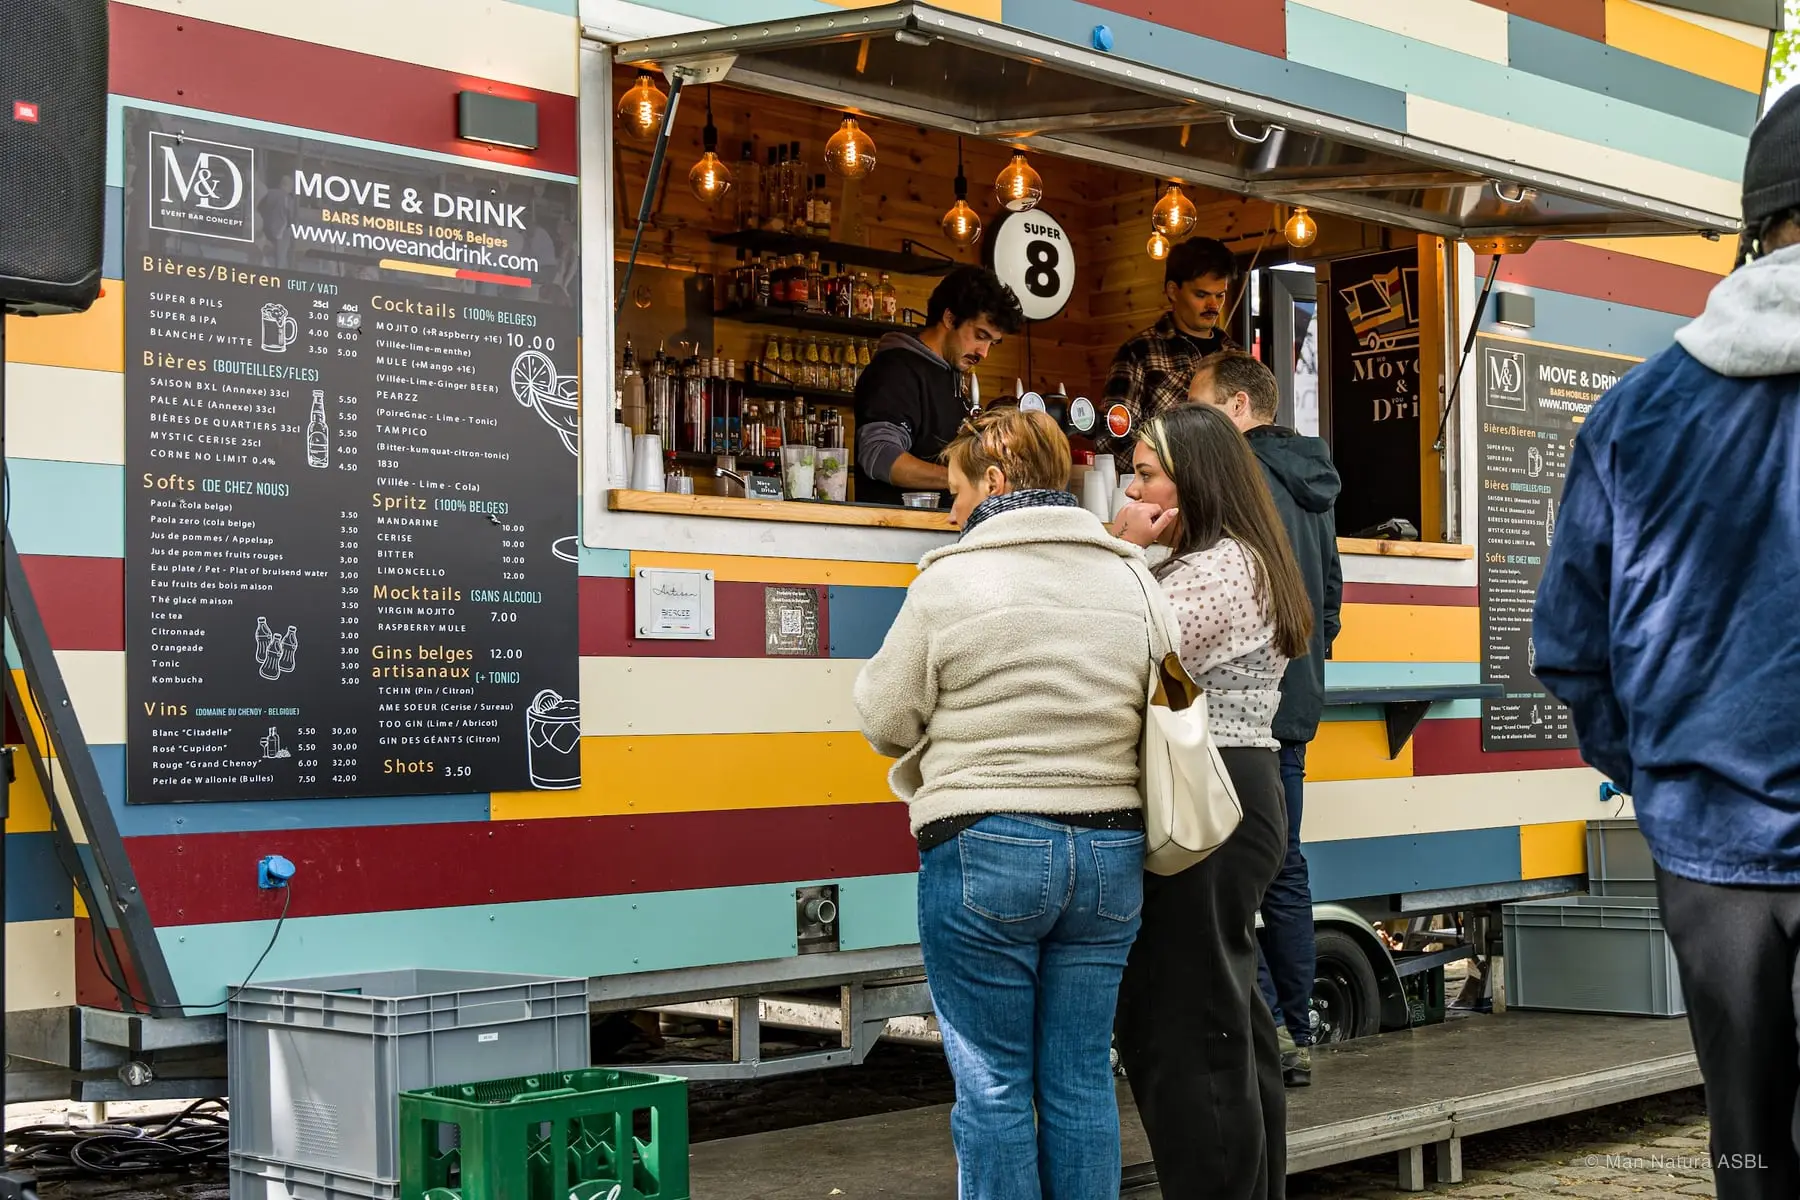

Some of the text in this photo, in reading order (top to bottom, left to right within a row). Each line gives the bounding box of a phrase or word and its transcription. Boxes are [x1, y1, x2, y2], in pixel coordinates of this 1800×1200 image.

[295, 170, 526, 230] MOVE & DRINK
[161, 209, 186, 218] EVENT
[206, 215, 243, 226] CONCEPT
[322, 209, 508, 248] BARS MOBILES 100% Belges
[1023, 222, 1061, 240] SUPER
[291, 223, 539, 273] www.moveanddrink.com
[143, 256, 281, 288] Bières/Bieren
[1025, 240, 1060, 297] 8
[287, 279, 307, 292] (FUT
[318, 282, 338, 295] VAT)
[150, 292, 223, 308] SUPER 8 PILS
[313, 300, 358, 312] 25cl 40cl
[371, 295, 456, 319] Cocktails
[150, 310, 217, 324] SUPER 8 IPA
[308, 312, 329, 321] 3.00
[463, 307, 536, 327] (100% BELGES)
[150, 328, 205, 341] BLANCHE
[217, 335, 253, 347] WITTE
[308, 329, 358, 341] 4.00 6.00
[376, 322, 502, 345] MOJITO (+Raspberry +1€)
[376, 340, 472, 357] (Villée-lime-menthe)
[507, 333, 555, 351] 10.00
[309, 346, 358, 358] 3.50 5.00
[143, 351, 319, 382] Bières (BOUTEILLES/FLES)
[376, 357, 475, 375] MULE (+Mango +1€)
[1540, 365, 1577, 385] MOVE
[1580, 371, 1589, 387] &
[150, 377, 290, 398] SAISON BXL (Annexe) 33cl
[376, 374, 499, 393] (Villée-Lime-Ginger BEER)
[1396, 379, 1408, 393] &
[338, 396, 358, 404] 5.50
[376, 391, 418, 402] PEARZZ
[1550, 388, 1590, 400] BARS MOBILES
[150, 396, 275, 414] PALE ALE (Annexe) 33cl
[150, 413, 300, 433] BIÈRES DE QUARTIERS 33cl
[338, 413, 358, 421] 5.50
[338, 430, 358, 438] 5.50
[376, 425, 428, 437] TAMPICO
[1483, 423, 1536, 438] Bières/Bieren
[151, 431, 261, 447] MYSTIC CERISE 25cl
[337, 446, 358, 454] 4.00
[376, 442, 509, 460] (Bitter-kumquat-citron-tonic)
[151, 449, 276, 466] CORNE NO LIMIT 0.4%
[377, 460, 399, 468] 1830
[338, 463, 358, 472] 4.50
[143, 473, 289, 497] Softs (DE CHEZ NOUS)
[1484, 480, 1509, 492] Bières
[372, 493, 427, 511] Spritz
[434, 499, 509, 515] (100% BELGES)
[377, 517, 439, 528] MANDARINE
[502, 525, 525, 533] 10.00
[377, 534, 413, 542] CERISE
[502, 540, 525, 548] 10.00
[377, 551, 414, 559] BITTER
[1485, 552, 1506, 563] Softs
[377, 567, 445, 577] LIMONCELLO
[503, 572, 525, 580] 12.00
[373, 585, 461, 601] Mocktails
[471, 590, 542, 604] (SANS ALCOOL)
[377, 606, 455, 616] VIRGIN MOJITO
[490, 612, 517, 622] 7.00
[152, 628, 206, 636] Citronnade
[378, 624, 467, 633] RASPBERRY MULE
[152, 644, 204, 653] Orangeade
[372, 645, 473, 663] Gins belges
[490, 648, 523, 659] 12.00
[152, 660, 180, 668] Tonic
[372, 664, 470, 679] artisanaux
[489, 672, 520, 684] TONIC)
[152, 676, 203, 684] Kombucha
[341, 677, 360, 685] 5.00
[379, 687, 475, 696] TCHIN (Pin Citron)
[144, 702, 187, 717] Vins
[238, 708, 262, 716] CHENOY
[379, 735, 500, 745] GIN DES GÉANTS (Citron)
[384, 759, 434, 774] Shots
[445, 766, 472, 777] 3.50
